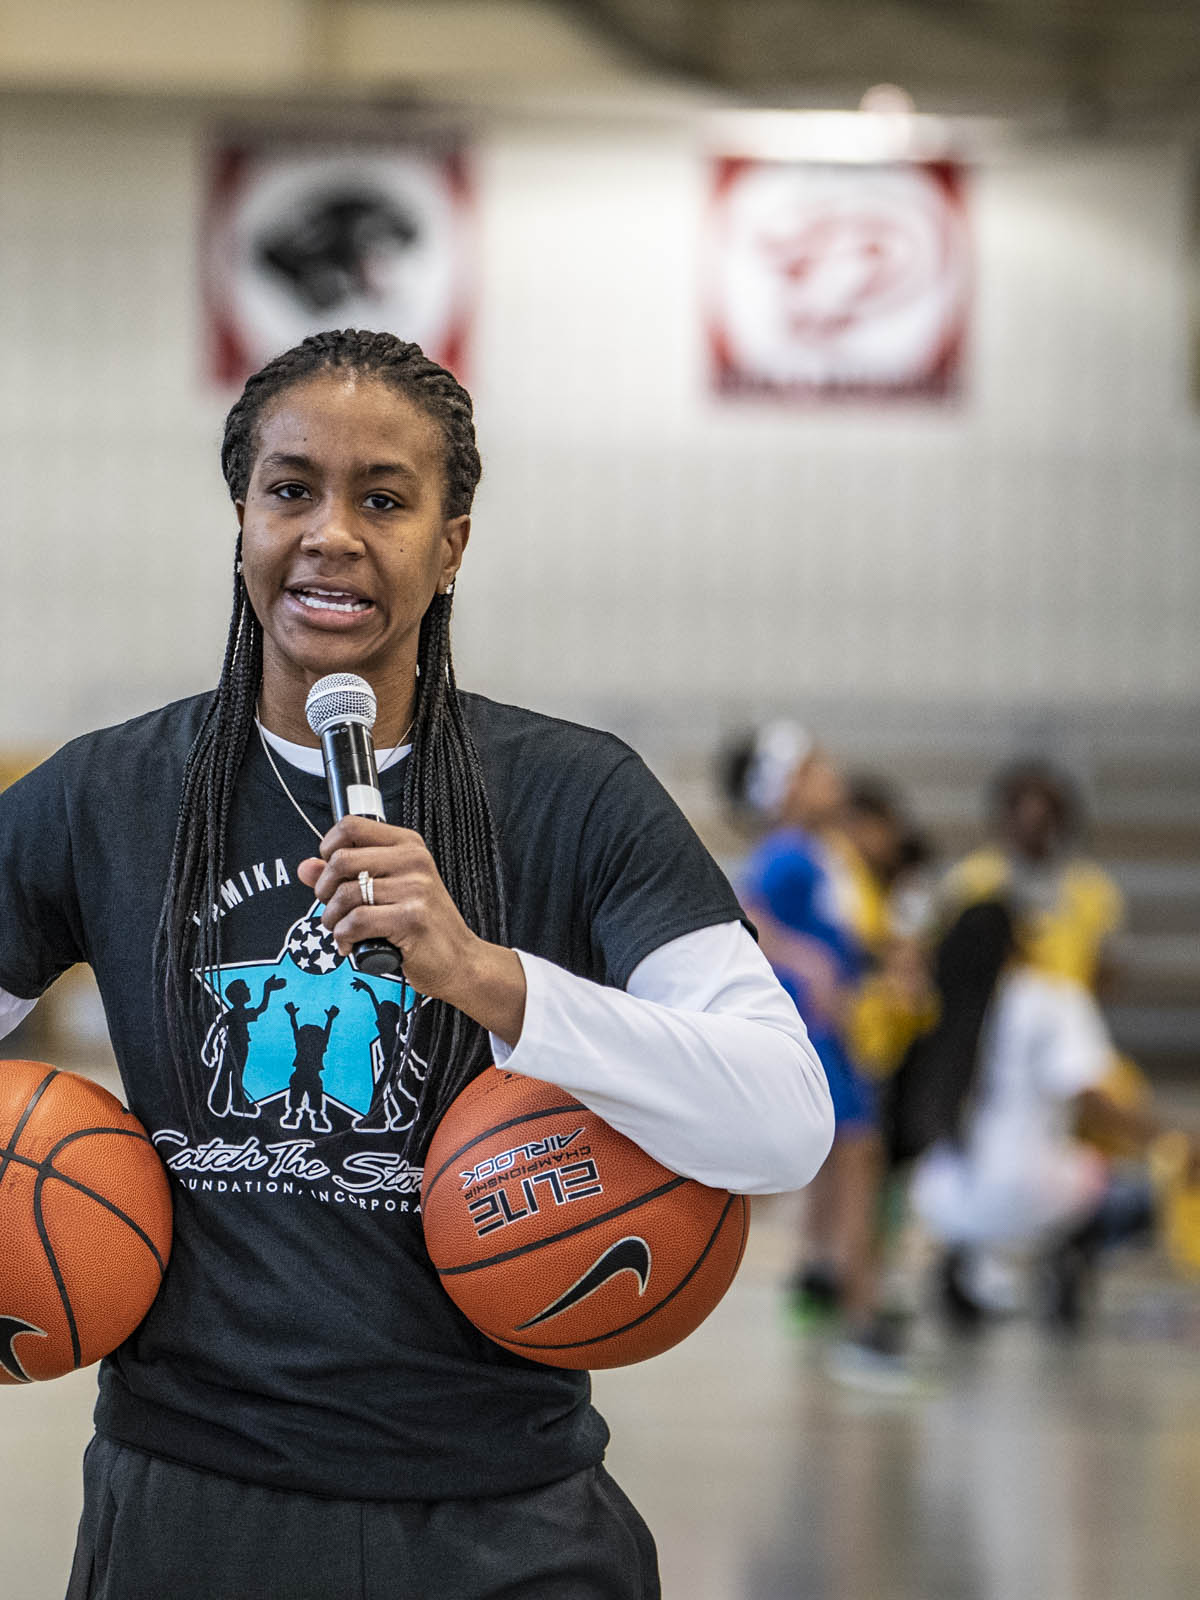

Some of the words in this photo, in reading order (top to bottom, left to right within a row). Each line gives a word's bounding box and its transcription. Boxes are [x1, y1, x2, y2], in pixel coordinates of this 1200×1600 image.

[264, 1139, 331, 1180] The
[458, 1127, 586, 1190] AIRLOCK
[463, 1145, 592, 1201] CHAMPIONSHIP
[179, 1178, 303, 1196] UNDATION,
[310, 1188, 422, 1214] INCORPORA
[468, 1158, 603, 1238] ELITE
